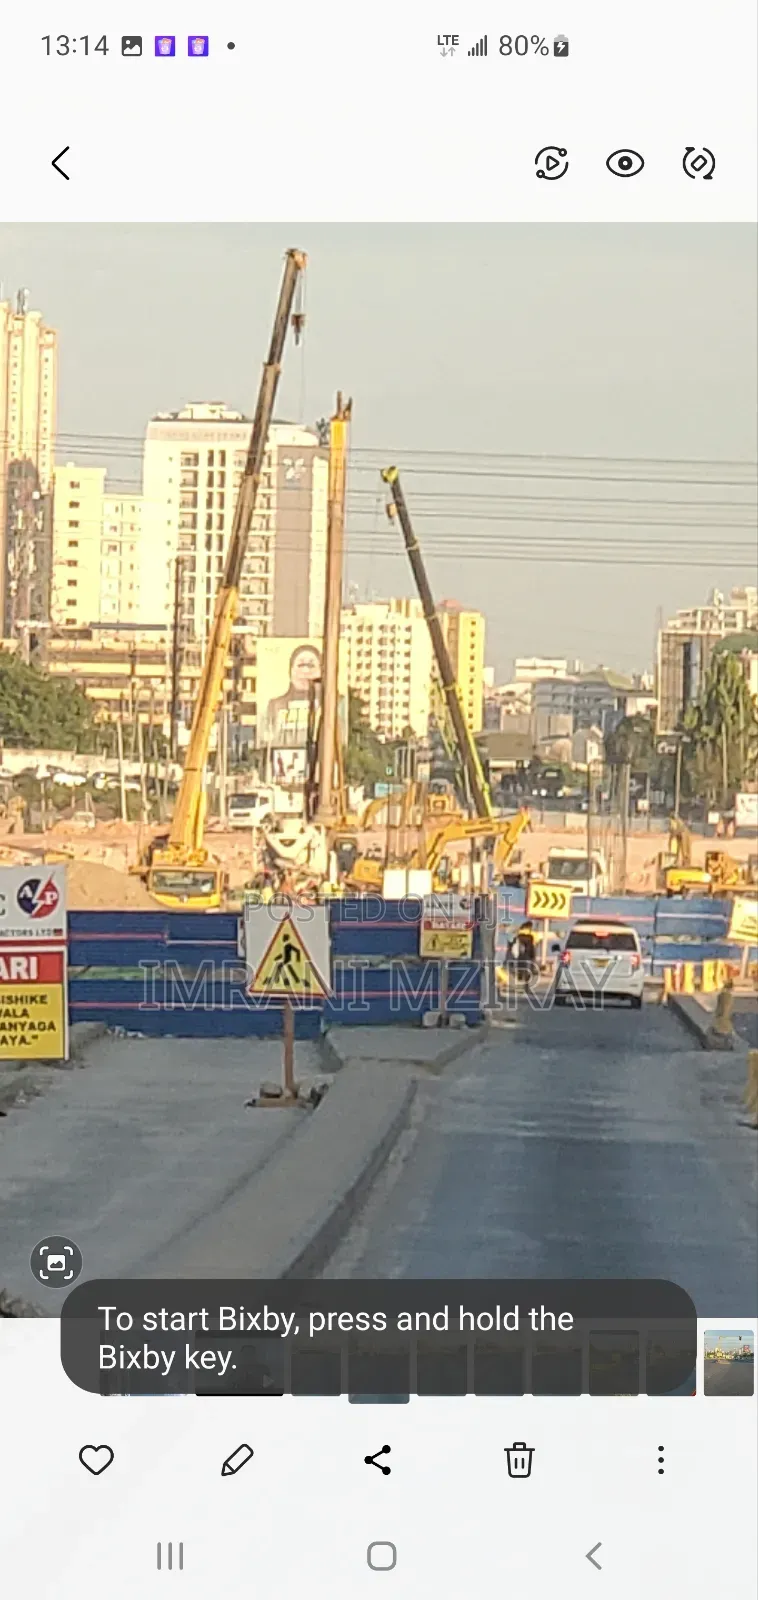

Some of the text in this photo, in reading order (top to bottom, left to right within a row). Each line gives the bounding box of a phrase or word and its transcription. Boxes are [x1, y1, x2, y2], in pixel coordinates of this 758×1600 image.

[41, 34, 110, 56] 13:14
[437, 34, 460, 46] LTE
[498, 34, 550, 57] 80%
[97, 1304, 574, 1339] To start Bixby, press and hold the
[98, 1343, 238, 1377] Bixby key.
